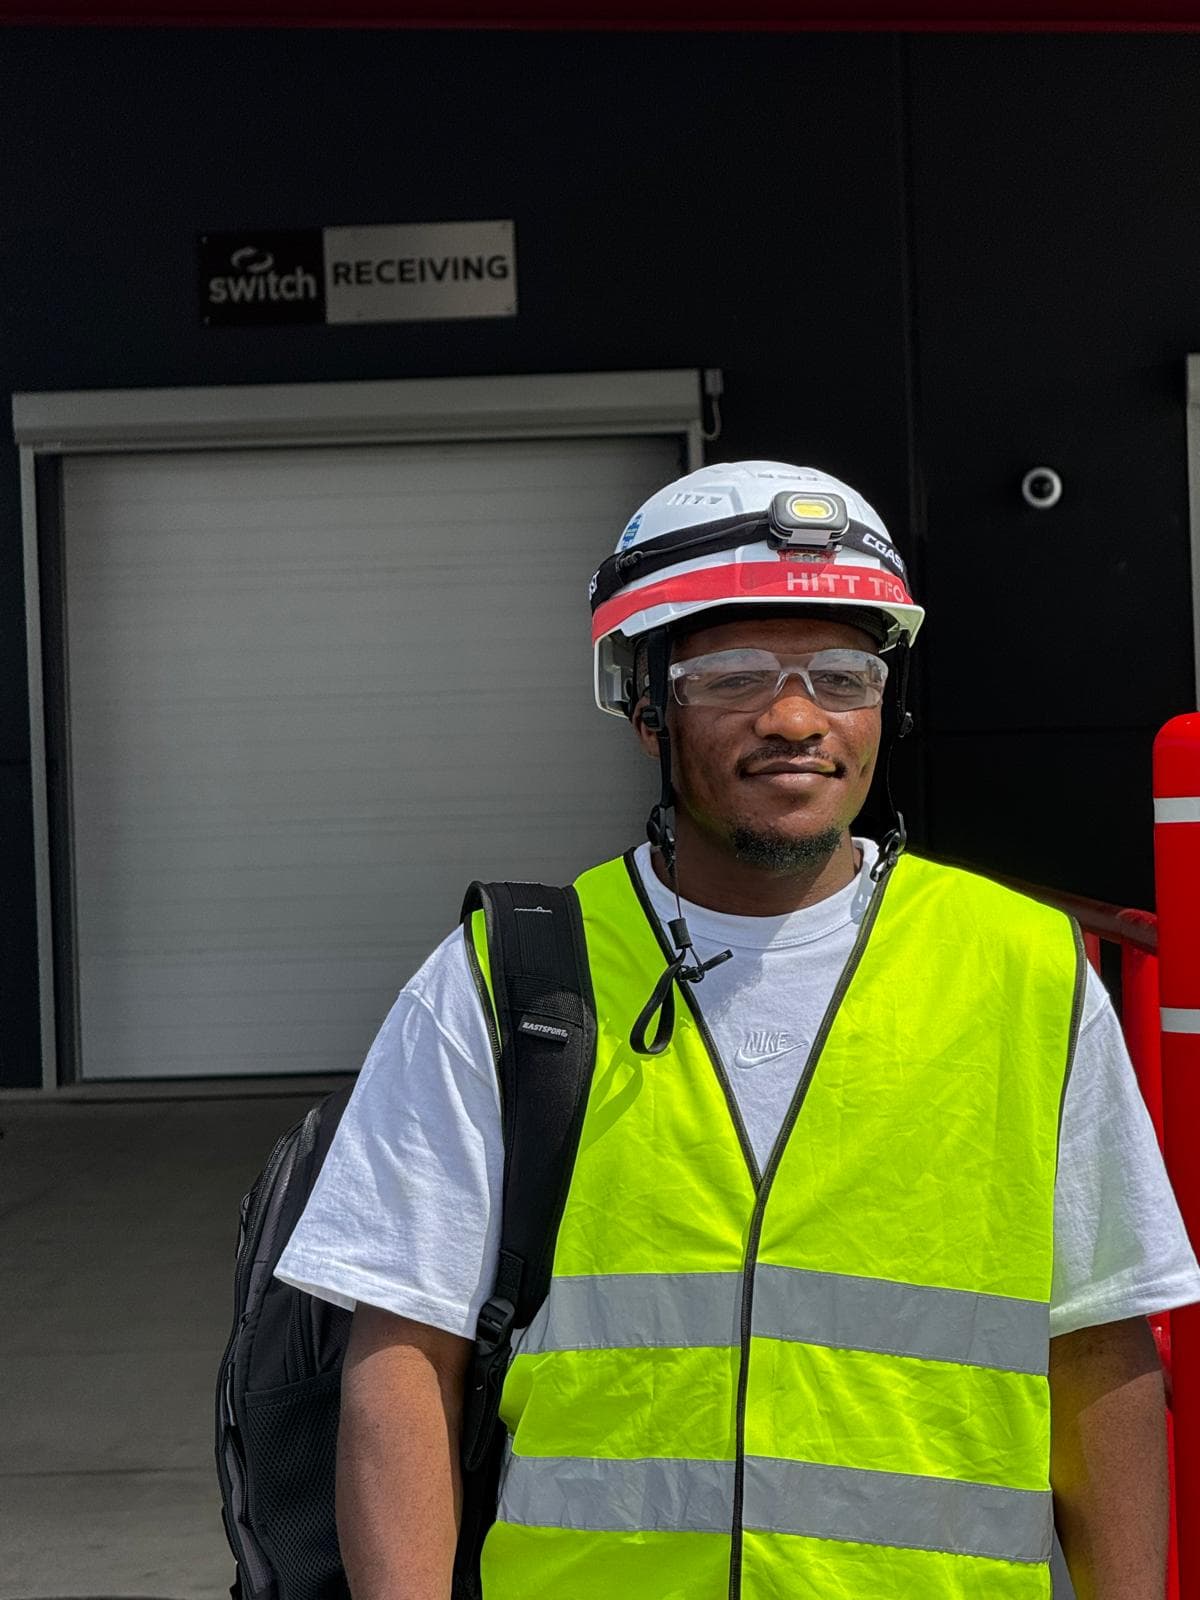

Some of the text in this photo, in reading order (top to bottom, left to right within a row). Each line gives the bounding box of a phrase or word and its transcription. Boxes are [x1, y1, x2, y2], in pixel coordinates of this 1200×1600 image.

[332, 255, 508, 286] RECEIVING
[209, 266, 316, 303] switch
[787, 571, 860, 593] HITT
[522, 1022, 567, 1037] EASTSPORT
[744, 1031, 790, 1053] NIKE
